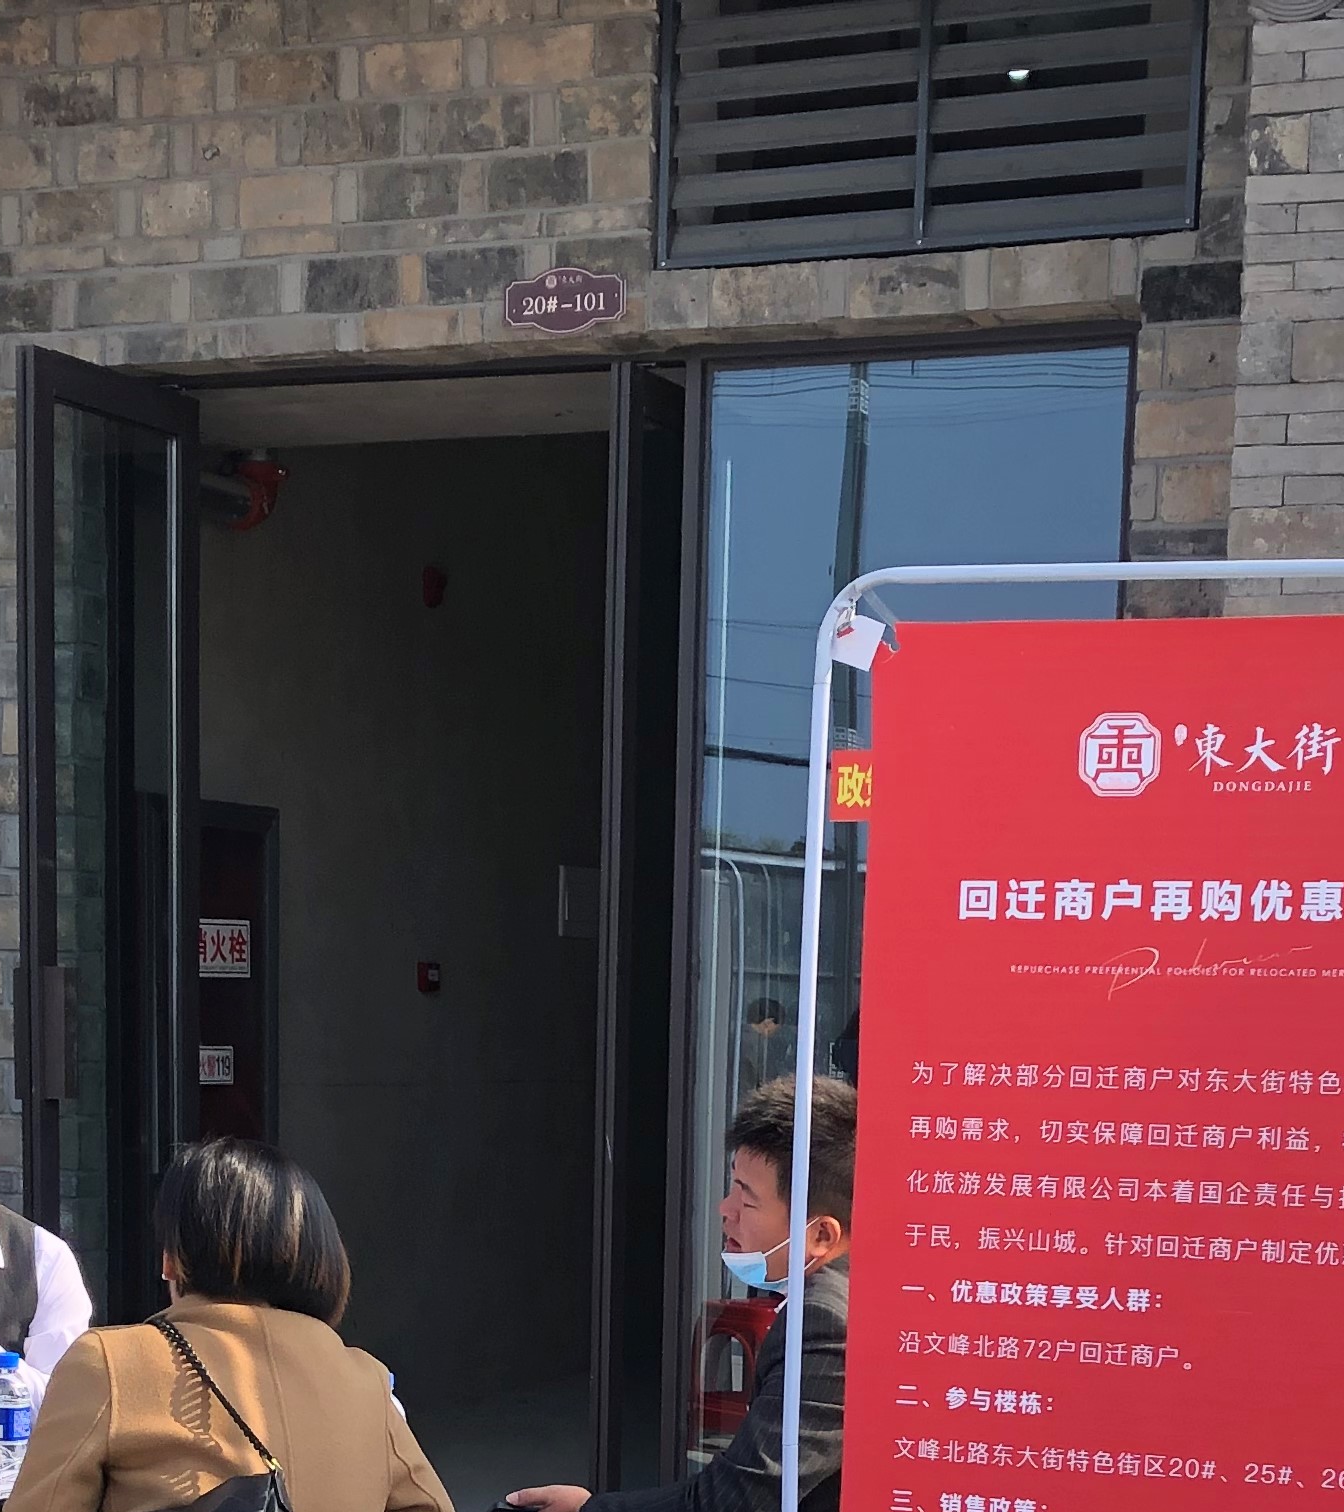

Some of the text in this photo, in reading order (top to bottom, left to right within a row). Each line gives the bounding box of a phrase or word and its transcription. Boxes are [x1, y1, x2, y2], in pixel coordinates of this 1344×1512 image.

[522, 292, 605, 316] 20#-101
[1189, 723, 1341, 776] 東大街
[1213, 781, 1311, 792] DONGDAJIE
[1010, 965, 1080, 975] REPURCHASE
[1085, 966, 1161, 976] PREFERENTIAL
[1167, 966, 1218, 976] POLICIES
[1223, 968, 1244, 977] FOR
[1250, 968, 1317, 977] RELOCATED
[902, 1280, 1163, 1312] 一、优惠政策享受人群：
[899, 1331, 1191, 1369] 沿文峰北路72户回迁商户。
[896, 1385, 1054, 1414] 二、参与楼栋：
